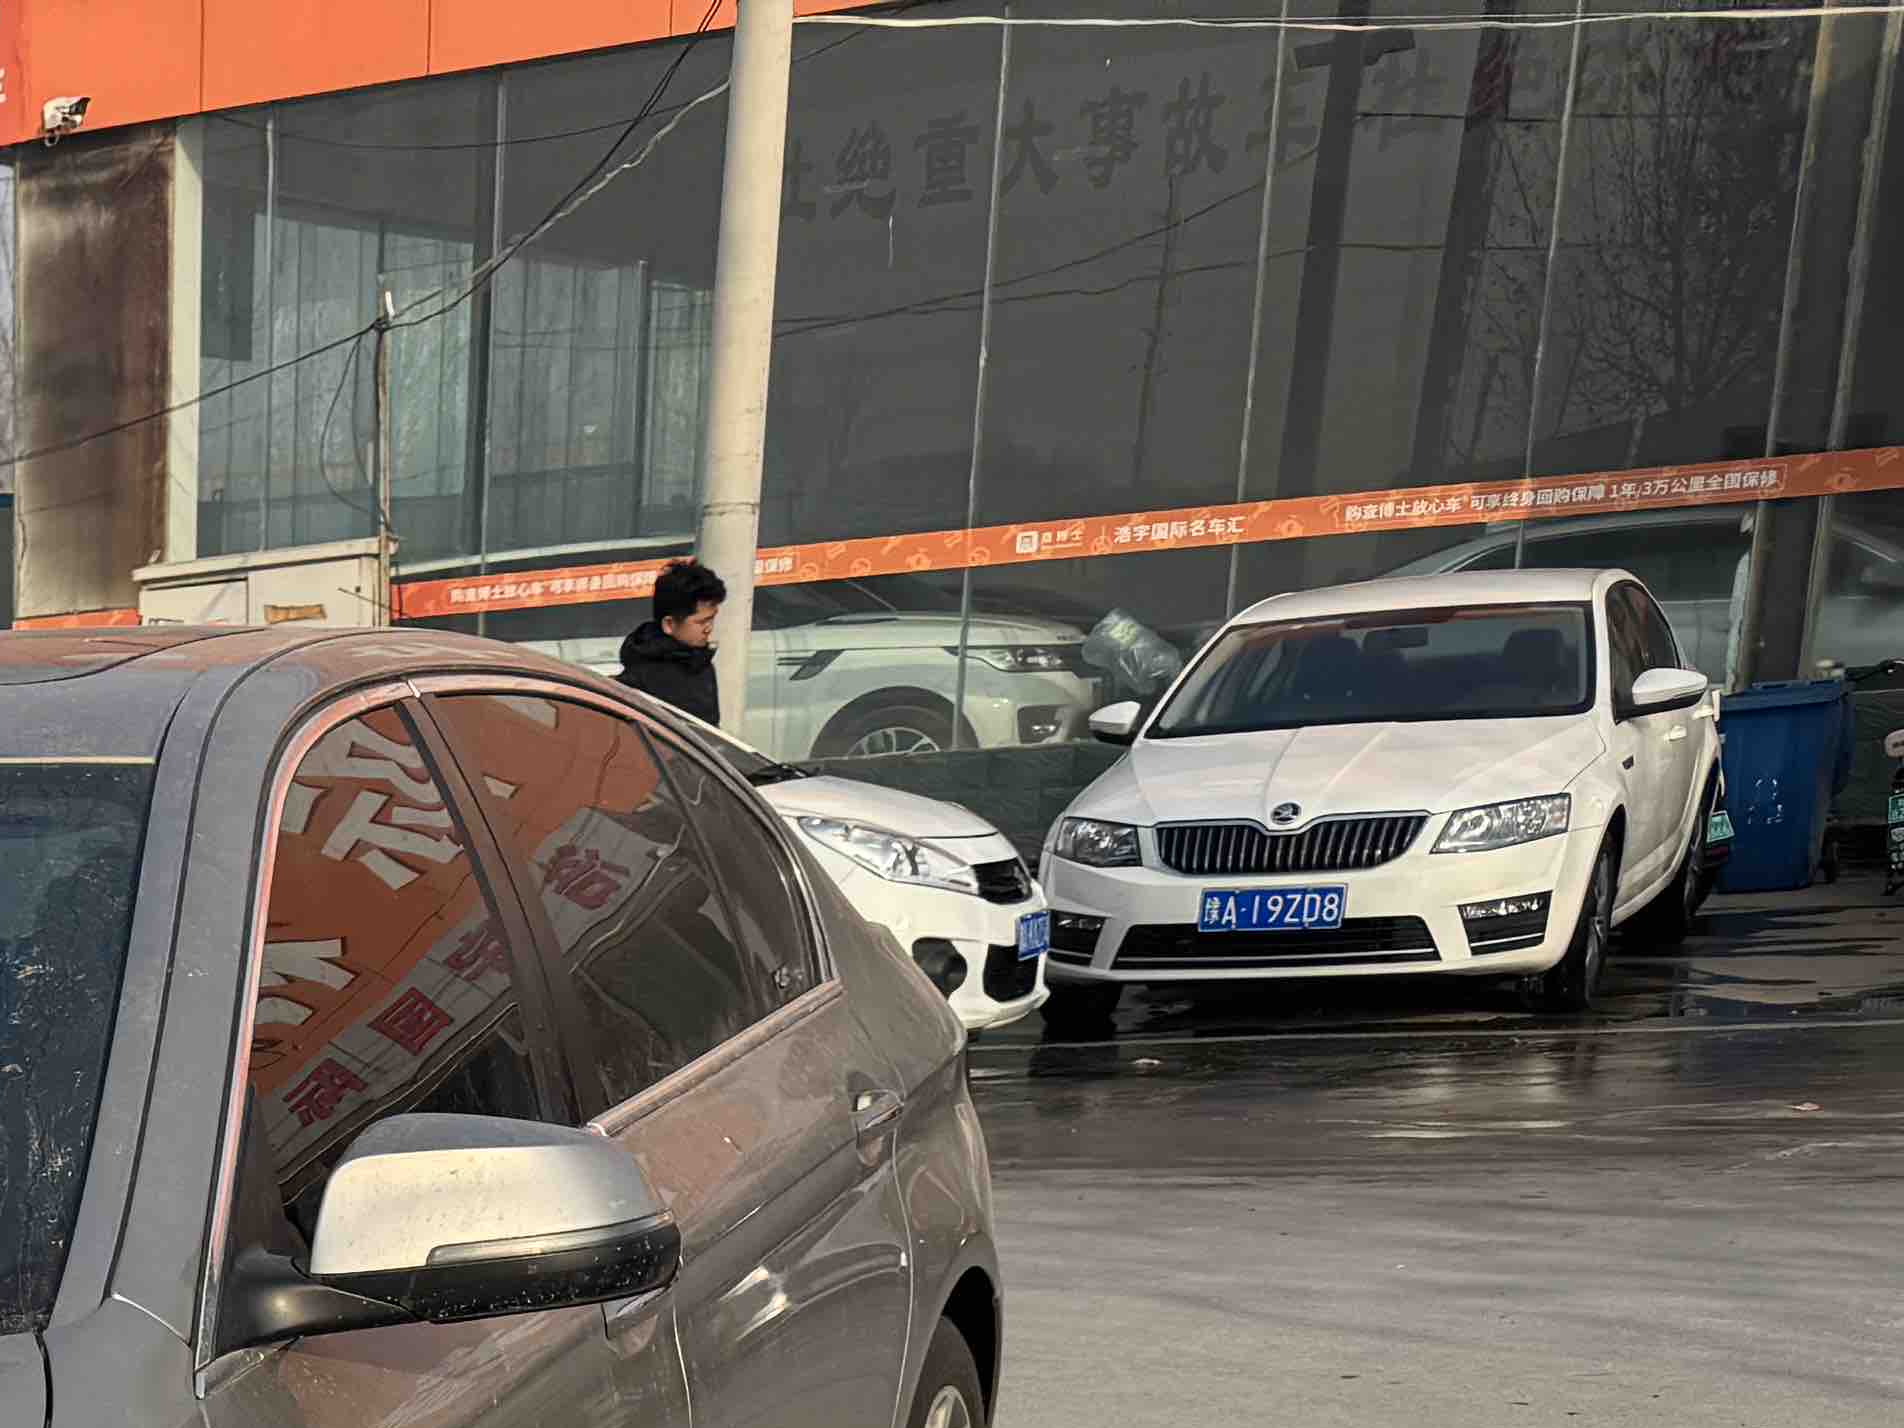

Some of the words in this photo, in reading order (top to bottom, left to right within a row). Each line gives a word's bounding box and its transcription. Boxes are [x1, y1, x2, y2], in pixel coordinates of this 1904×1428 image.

[1113, 516, 1246, 544] 浩宇国际名车汇
